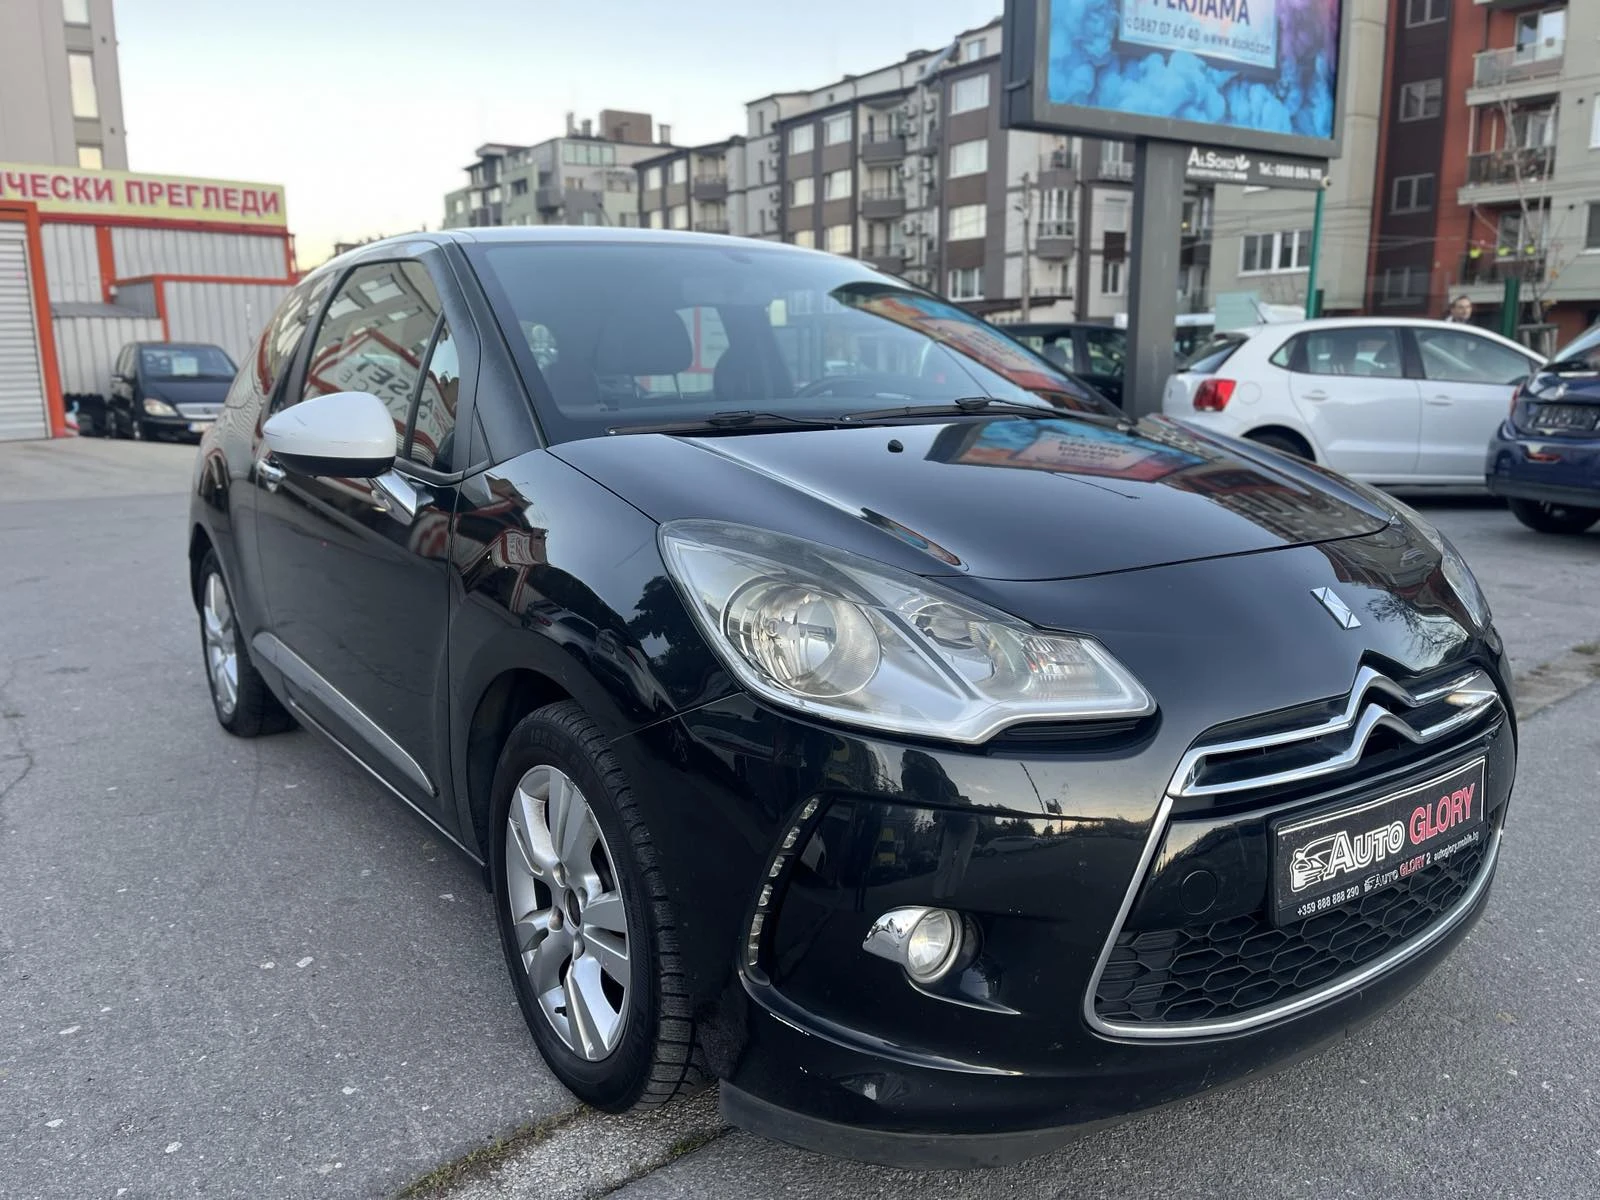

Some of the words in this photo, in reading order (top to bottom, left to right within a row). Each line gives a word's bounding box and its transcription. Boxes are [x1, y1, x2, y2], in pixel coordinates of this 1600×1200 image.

[1154, 0, 1251, 26] КЛАМА
[0, 172, 114, 200] ЧЕСКИ
[125, 180, 280, 217] ПРЕГЛЕДИ
[1409, 782, 1475, 845] GLORY
[1297, 901, 1316, 916] +359
[1317, 896, 1331, 910] 888
[1332, 891, 1346, 905] 888
[1347, 885, 1360, 899] 290
[1399, 854, 1425, 877] GLORY
[1426, 851, 1431, 865] 2
